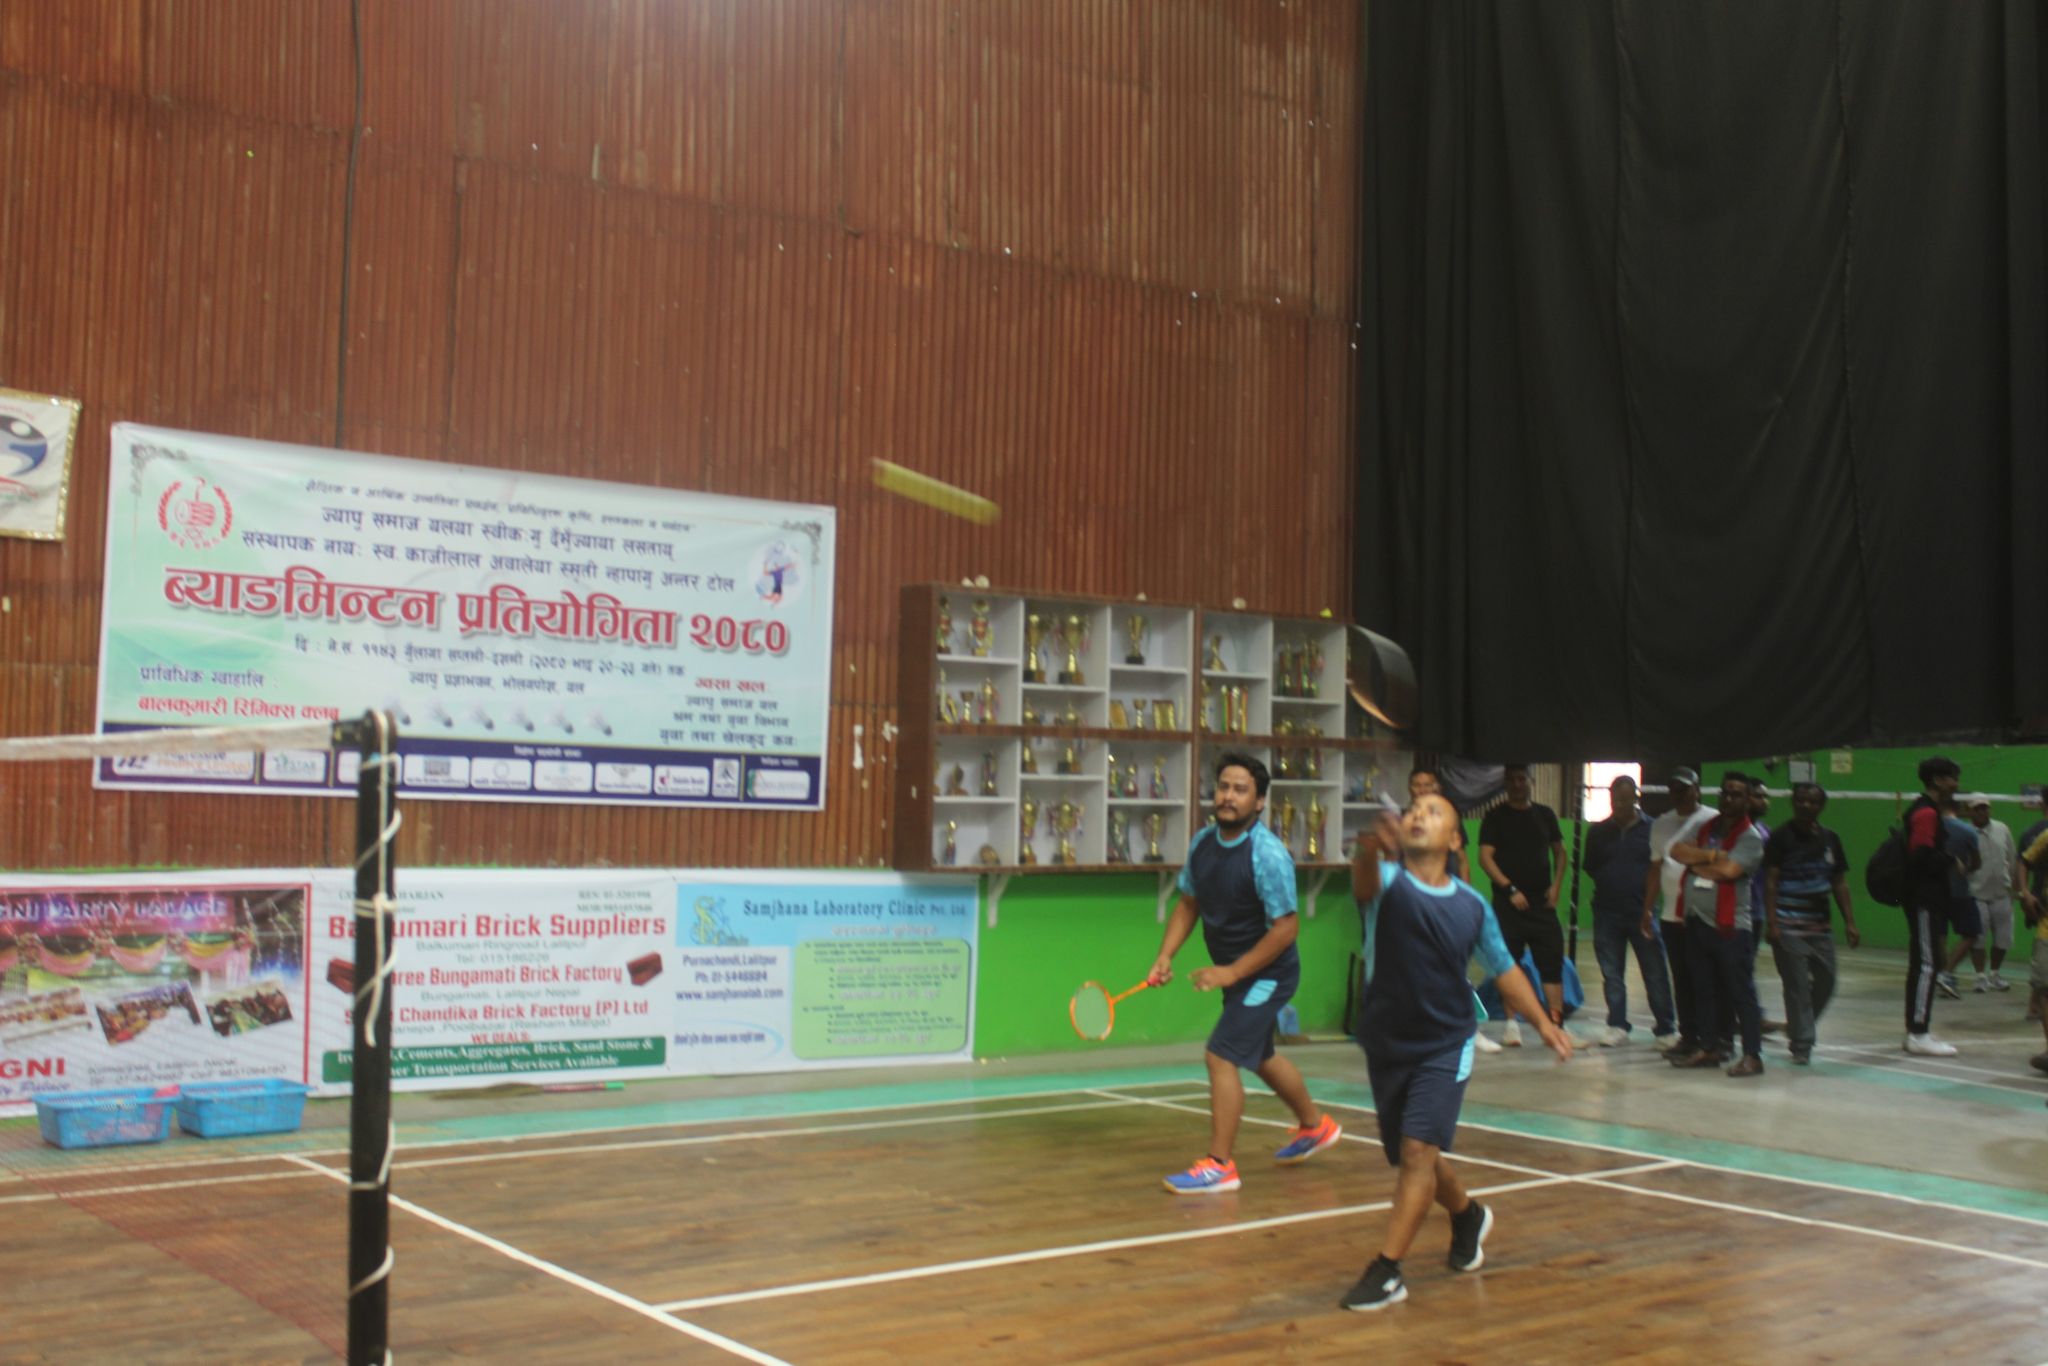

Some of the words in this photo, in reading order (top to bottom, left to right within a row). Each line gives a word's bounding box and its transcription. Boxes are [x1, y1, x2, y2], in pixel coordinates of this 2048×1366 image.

[322, 507, 363, 531] ज्यापु
[372, 511, 421, 530] समाज
[428, 518, 474, 537] यलया
[405, 544, 481, 569] काजीलाल
[706, 572, 736, 592] टोल
[164, 565, 440, 627] ब्याडमिन्टन
[456, 584, 677, 644] प्रतियोगिता
[689, 613, 786, 653] २०८०
[138, 695, 227, 718] बालकुमारी
[47, 899, 128, 921] PARTY
[136, 896, 228, 919] PALACE
[743, 899, 808, 920] Samjhana
[813, 899, 884, 919] Laboratory
[889, 900, 925, 916] Clinic
[329, 914, 467, 938] Baumari
[475, 913, 541, 937] Brick
[550, 912, 666, 940] Suppliers
[430, 965, 515, 987] Bungamati
[520, 963, 561, 983] Brick
[565, 963, 622, 985] Factory
[400, 1006, 478, 1023] Chandika
[483, 1004, 525, 1020] Brick
[530, 1002, 592, 1020] Factory
[624, 1000, 648, 1015] Ltd
[573, 1040, 603, 1052] Sand
[607, 1038, 640, 1051] Stone
[642, 1038, 654, 1050] &
[413, 1060, 509, 1078] Transportation
[510, 1056, 561, 1071] Services
[564, 1054, 619, 1067] Available
